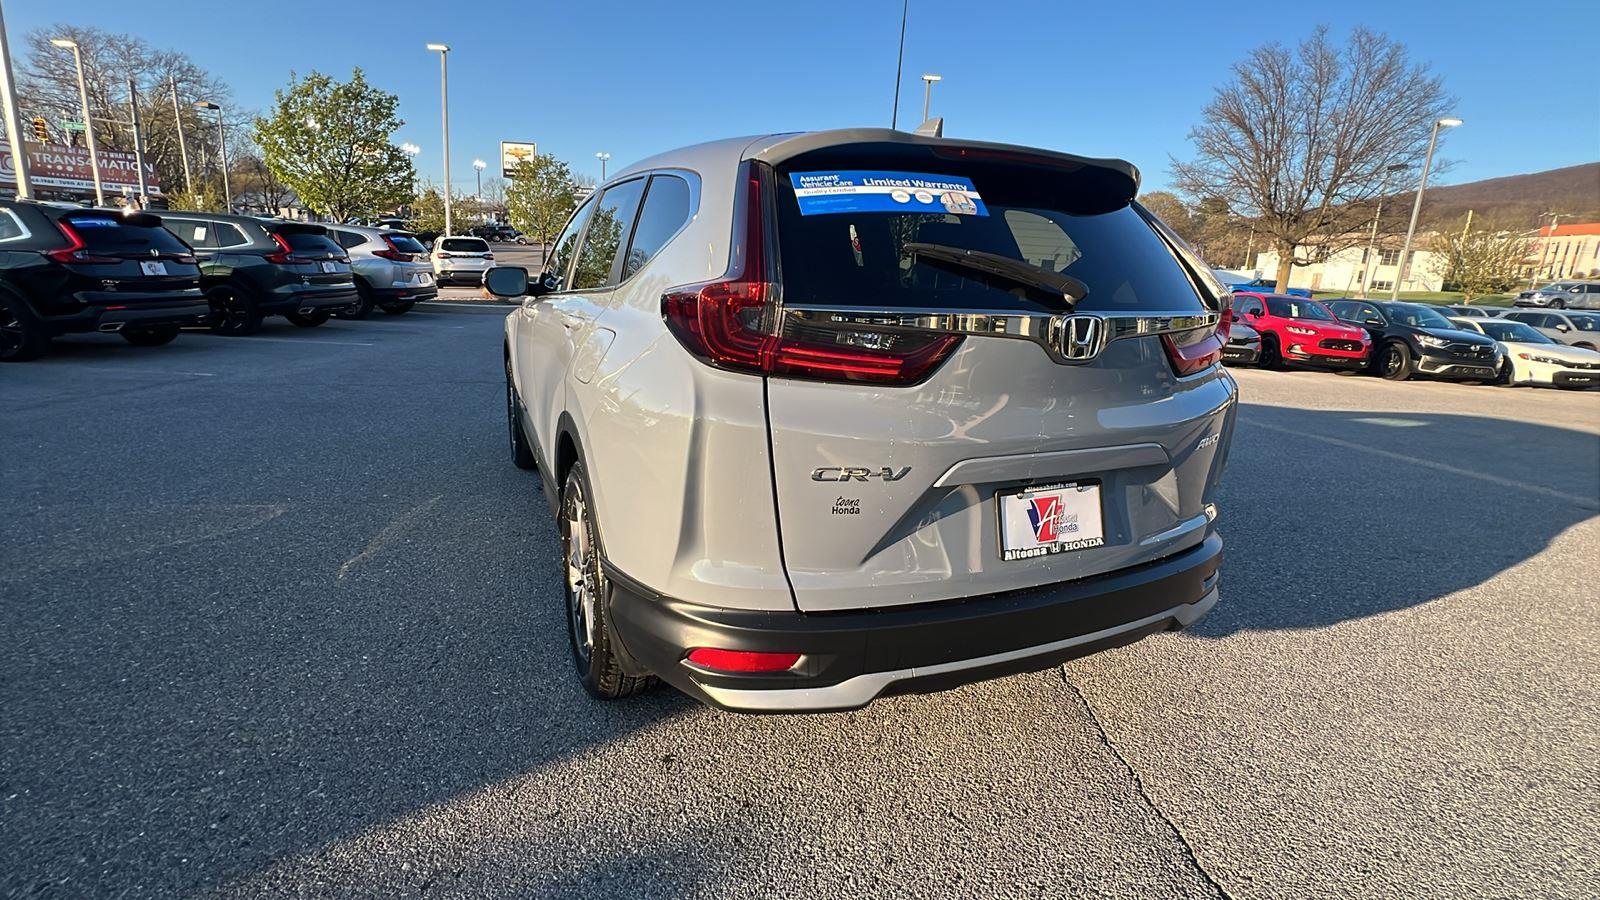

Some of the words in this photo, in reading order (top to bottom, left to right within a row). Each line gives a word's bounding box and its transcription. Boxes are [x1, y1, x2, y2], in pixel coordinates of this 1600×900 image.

[32, 152, 154, 173] TRANS4MATION
[801, 180, 833, 188] Vehicle
[863, 178, 911, 187] Limited
[911, 179, 968, 191] Warranty
[811, 467, 912, 482] CR-V
[836, 496, 860, 506] toona
[832, 506, 860, 515] Honda
[1053, 522, 1079, 534] Honda
[1004, 547, 1048, 561] Altoona
[1064, 537, 1105, 551] HONDA
